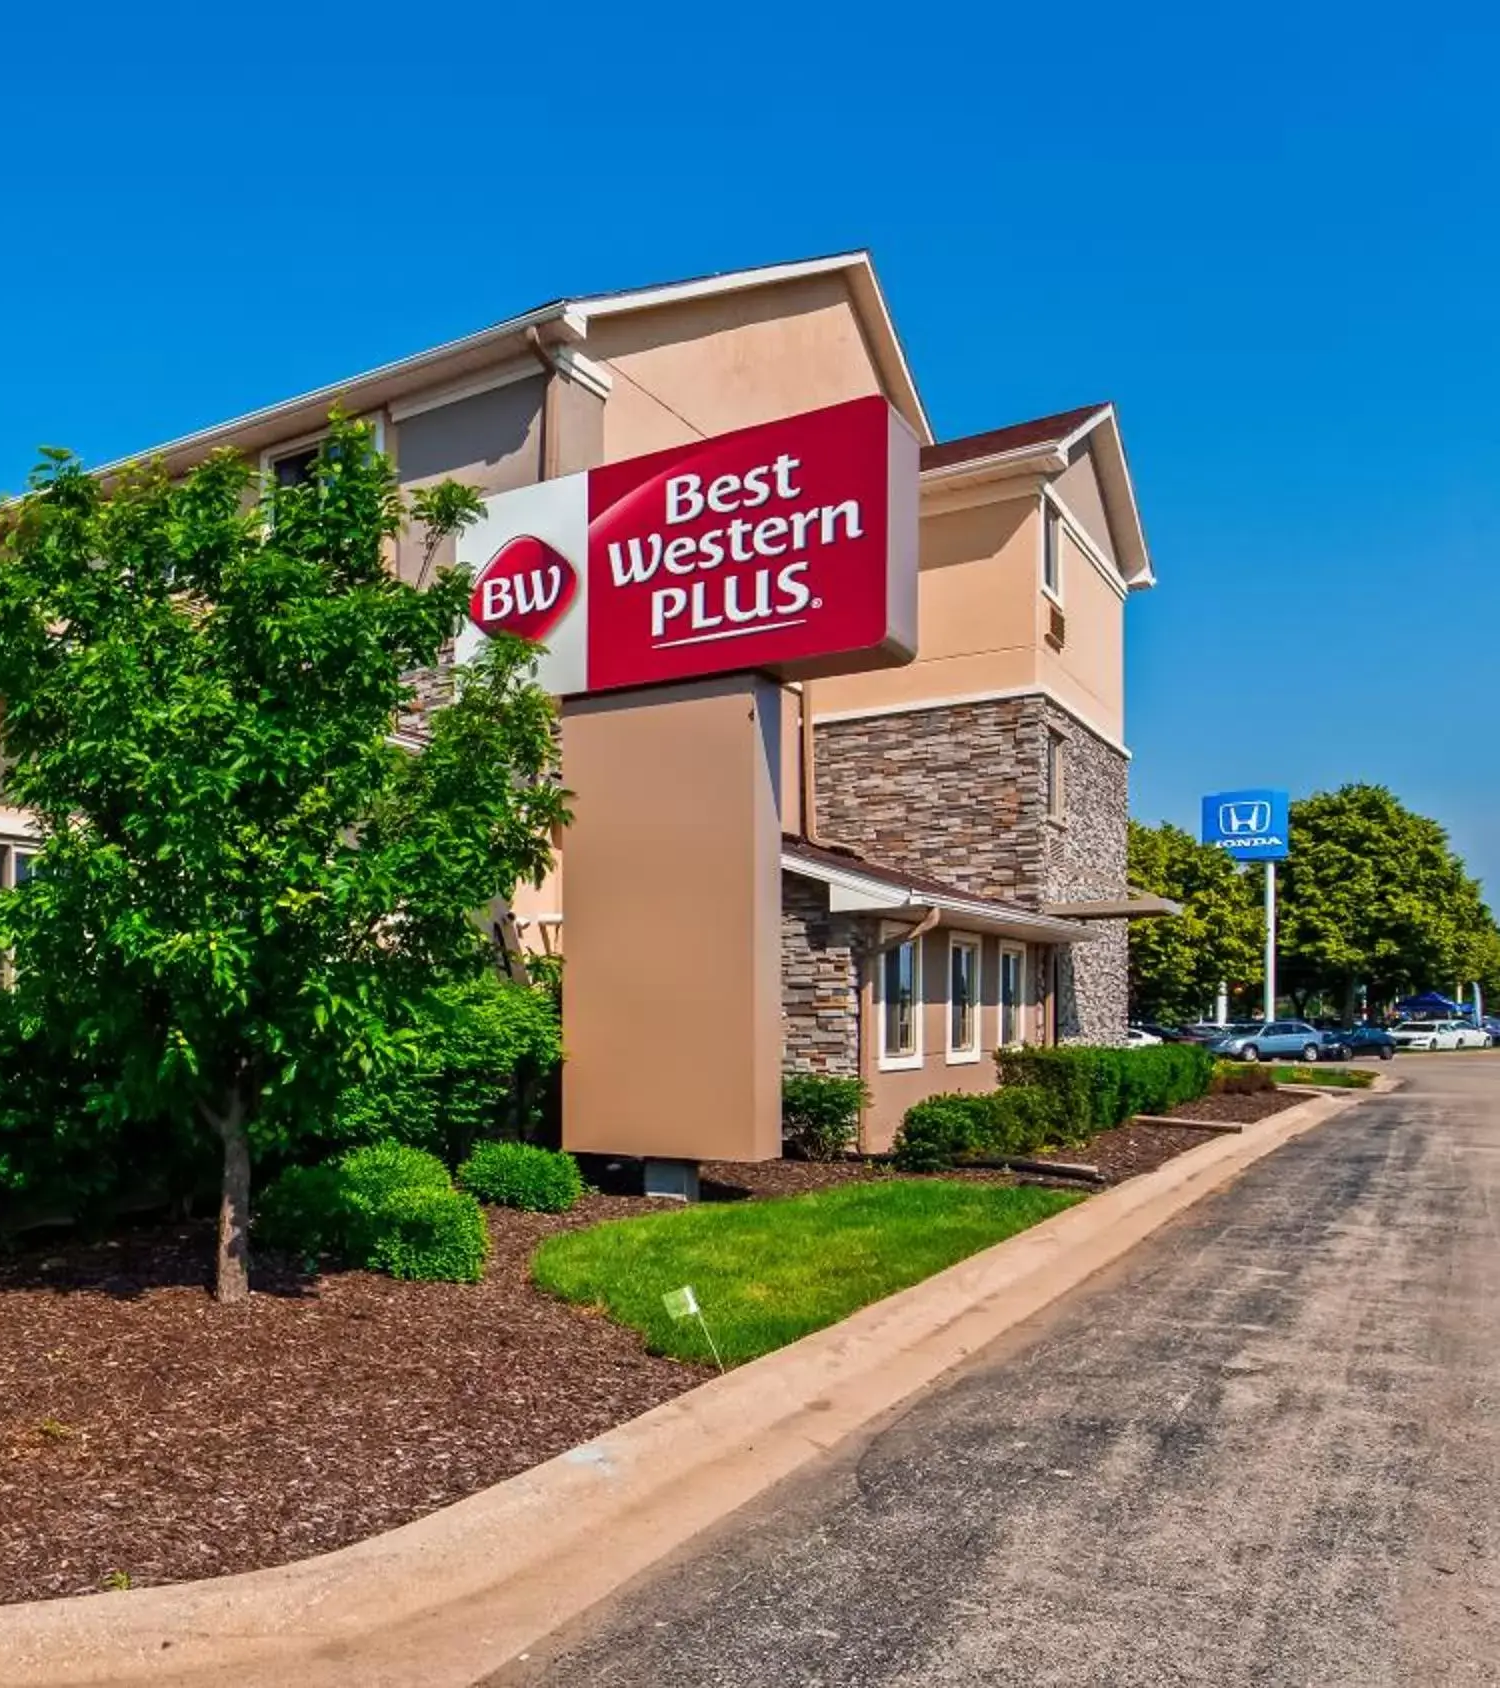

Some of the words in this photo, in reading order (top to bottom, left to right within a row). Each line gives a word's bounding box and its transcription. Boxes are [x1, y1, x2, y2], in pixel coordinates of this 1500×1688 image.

[665, 453, 802, 525] Best
[607, 499, 864, 588] Western
[482, 565, 561, 621] BW
